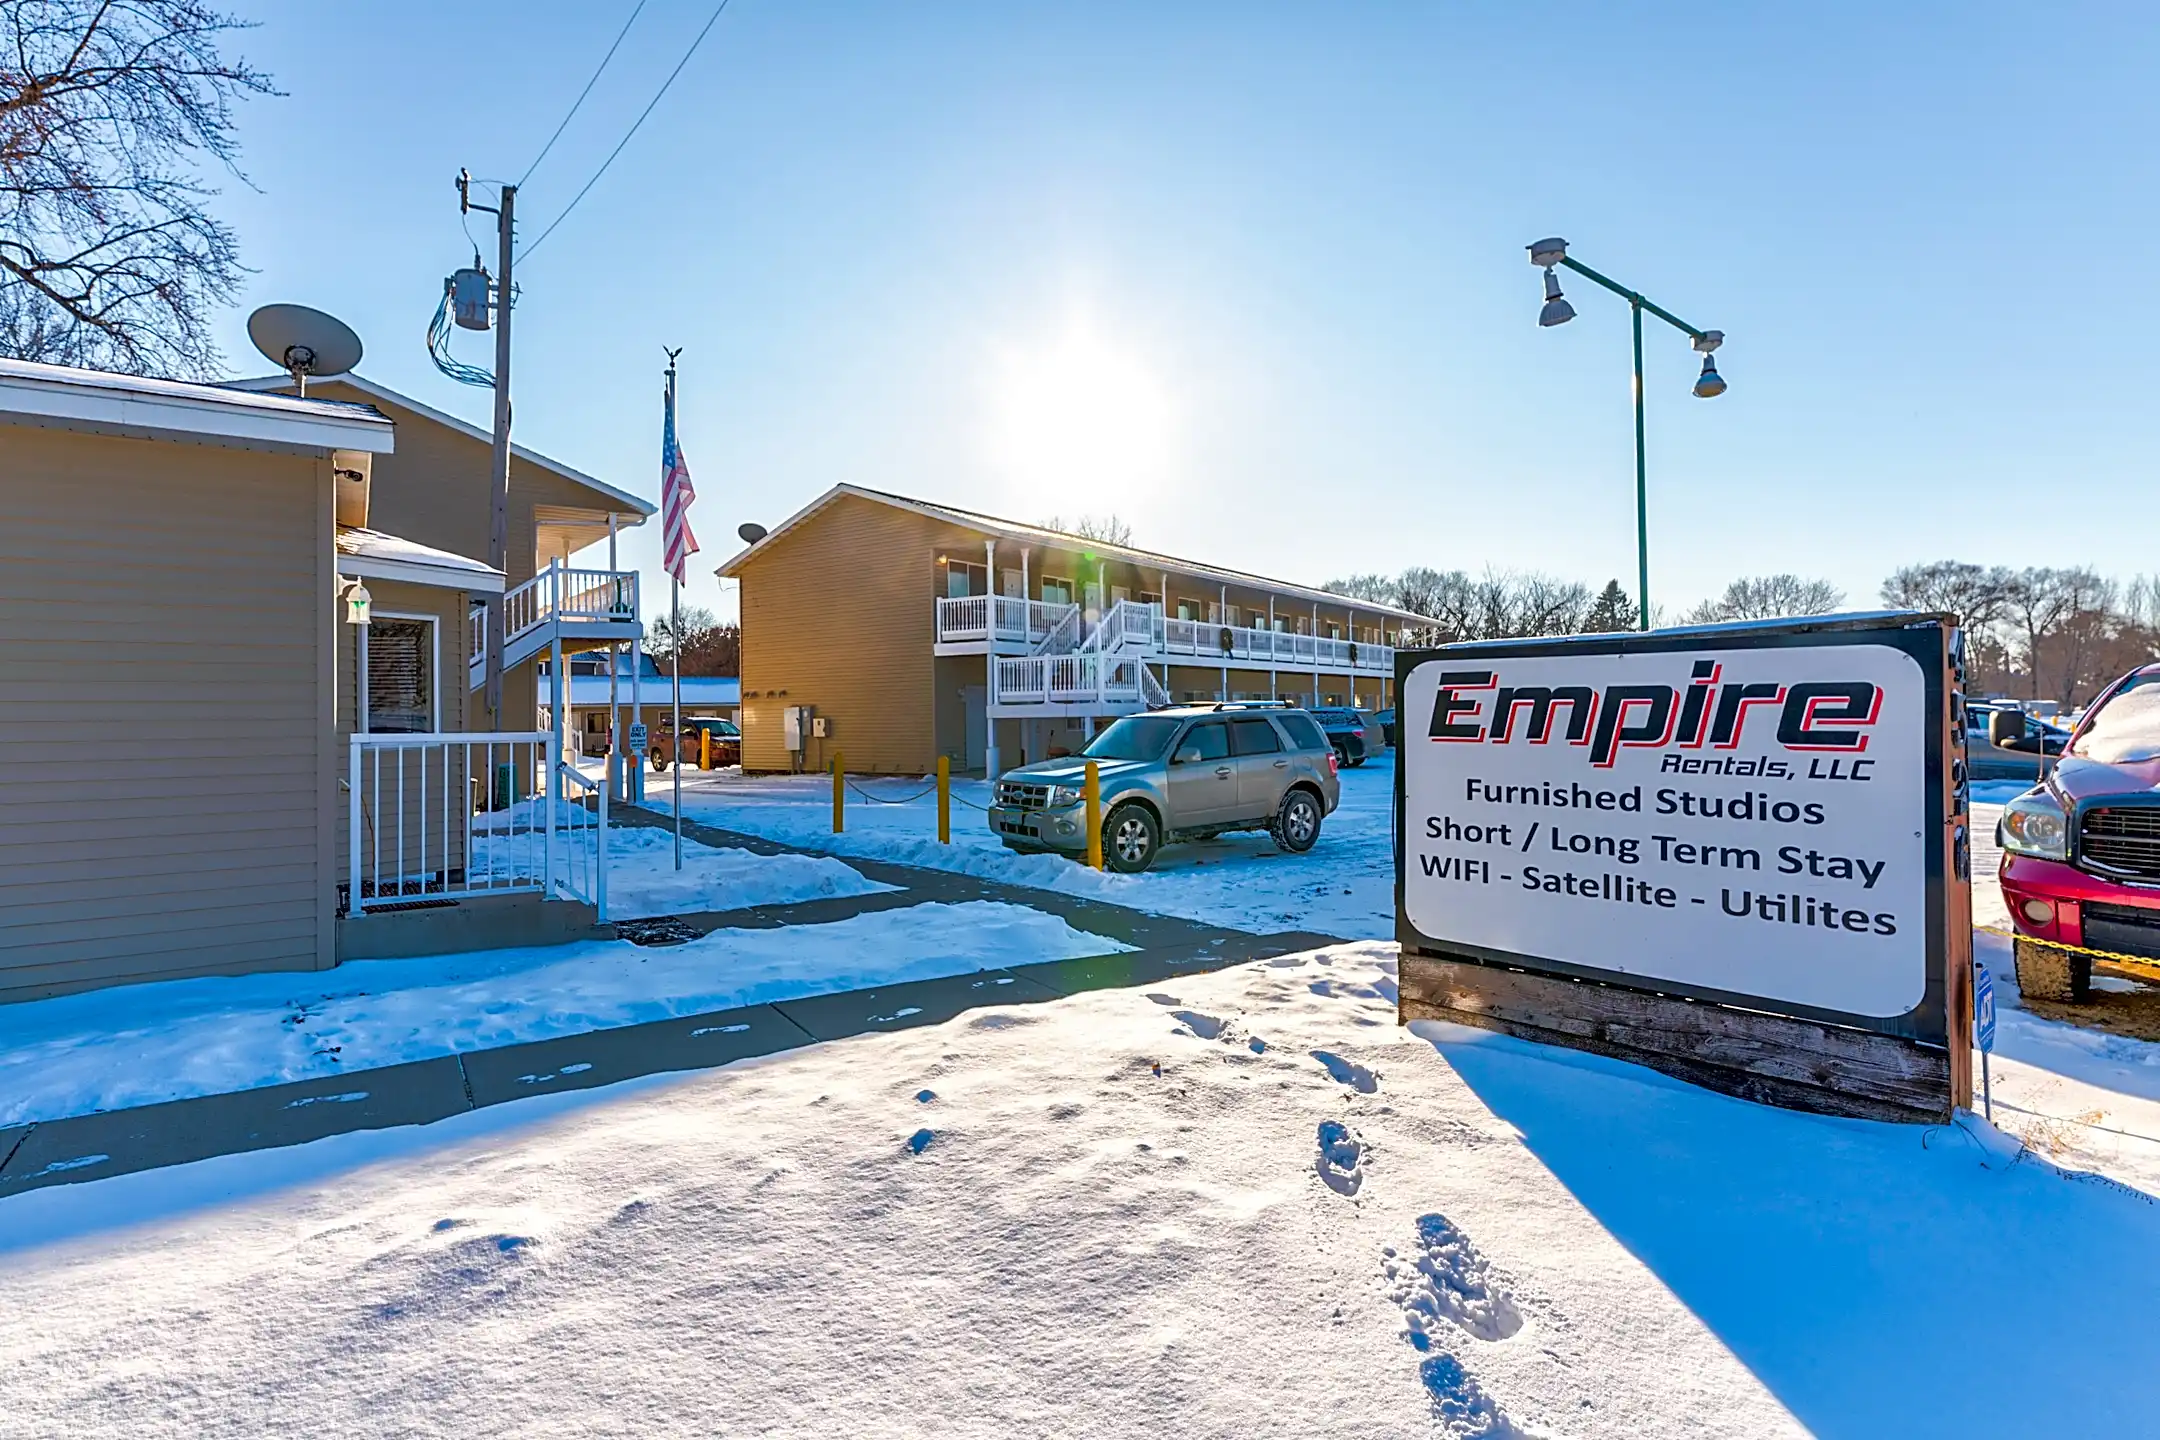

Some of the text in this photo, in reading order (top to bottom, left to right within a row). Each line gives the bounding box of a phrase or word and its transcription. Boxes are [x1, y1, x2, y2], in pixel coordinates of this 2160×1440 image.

[1428, 660, 1883, 768] Empire
[1660, 754, 1876, 781] Rentals, LLC
[1466, 778, 1825, 825] Furnished Studios
[1425, 816, 1887, 889] Short / Long Term Stay
[1419, 853, 1489, 885] WIFI
[1522, 866, 1678, 908] Satellite
[1720, 888, 1897, 936] Utilites
[1980, 989, 1993, 1033] ADT
